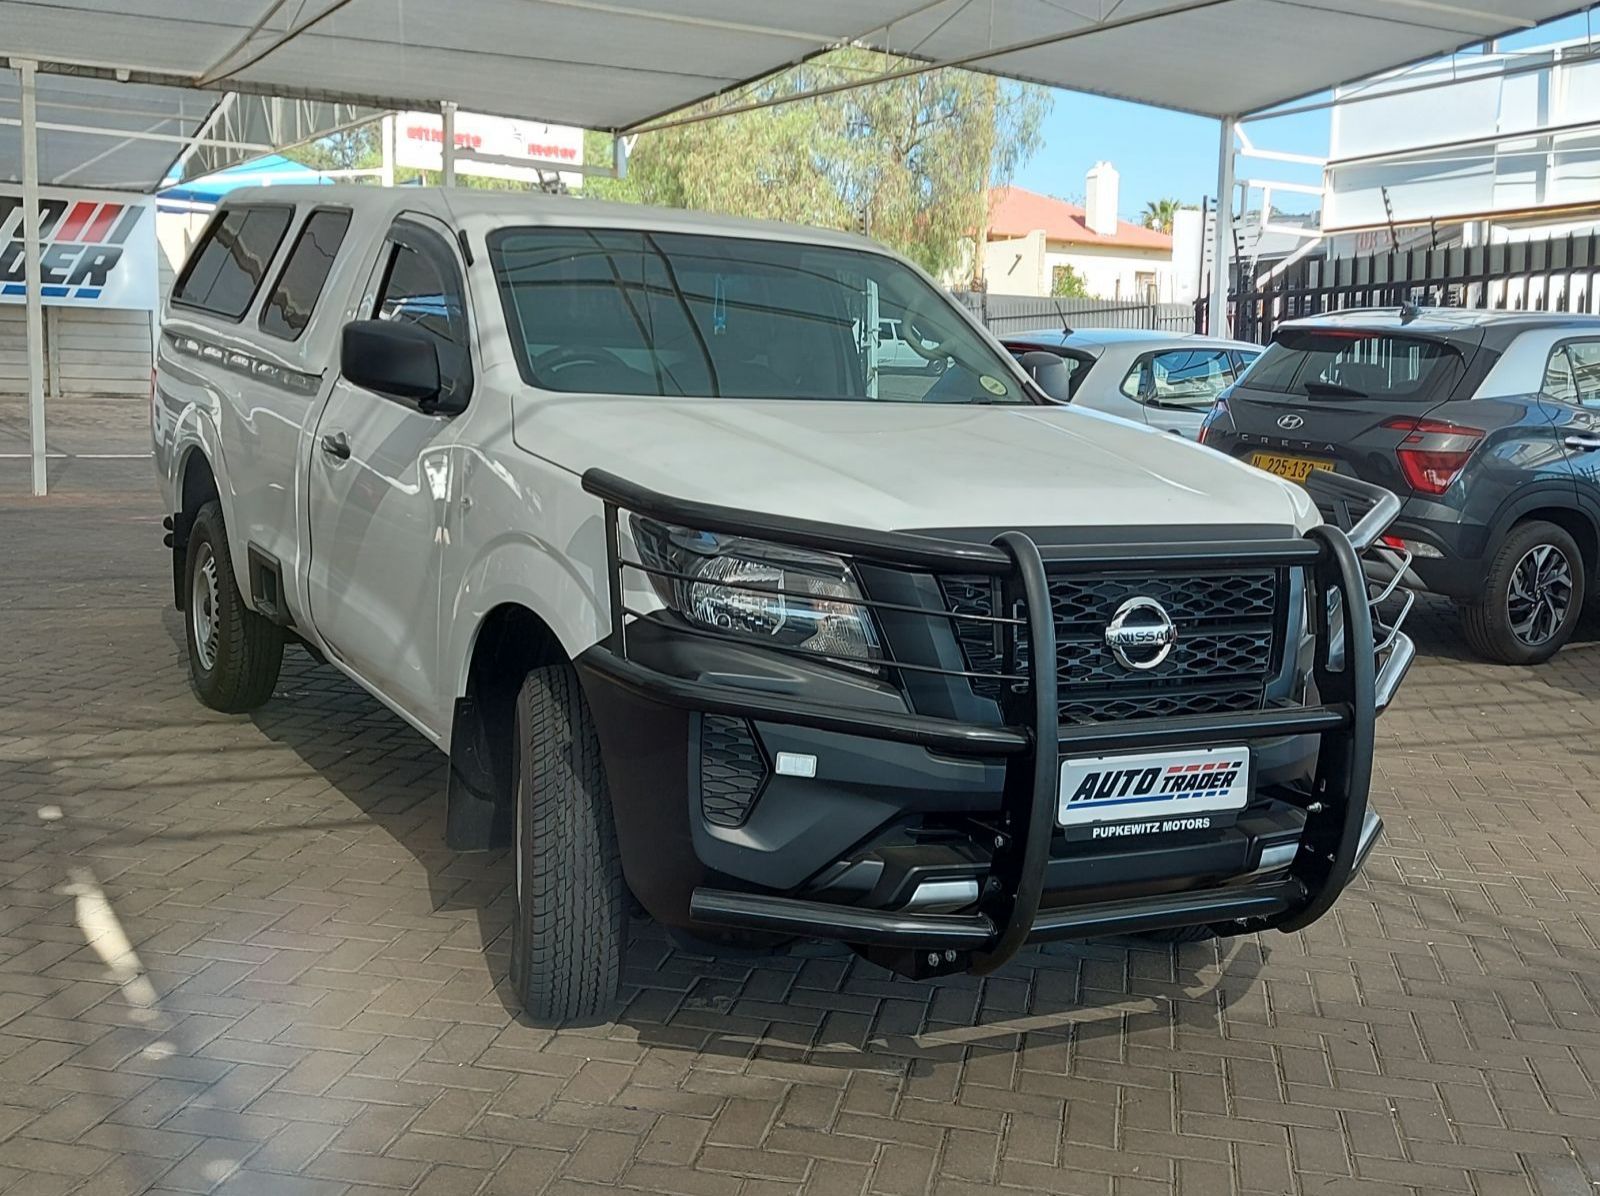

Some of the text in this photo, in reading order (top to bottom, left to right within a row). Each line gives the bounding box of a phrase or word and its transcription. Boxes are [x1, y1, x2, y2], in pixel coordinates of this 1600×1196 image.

[1241, 433, 1335, 451] CRETA
[1069, 767, 1238, 802] AUTO TRADER
[1092, 817, 1211, 839] PUPKEWITZ MOTORS
